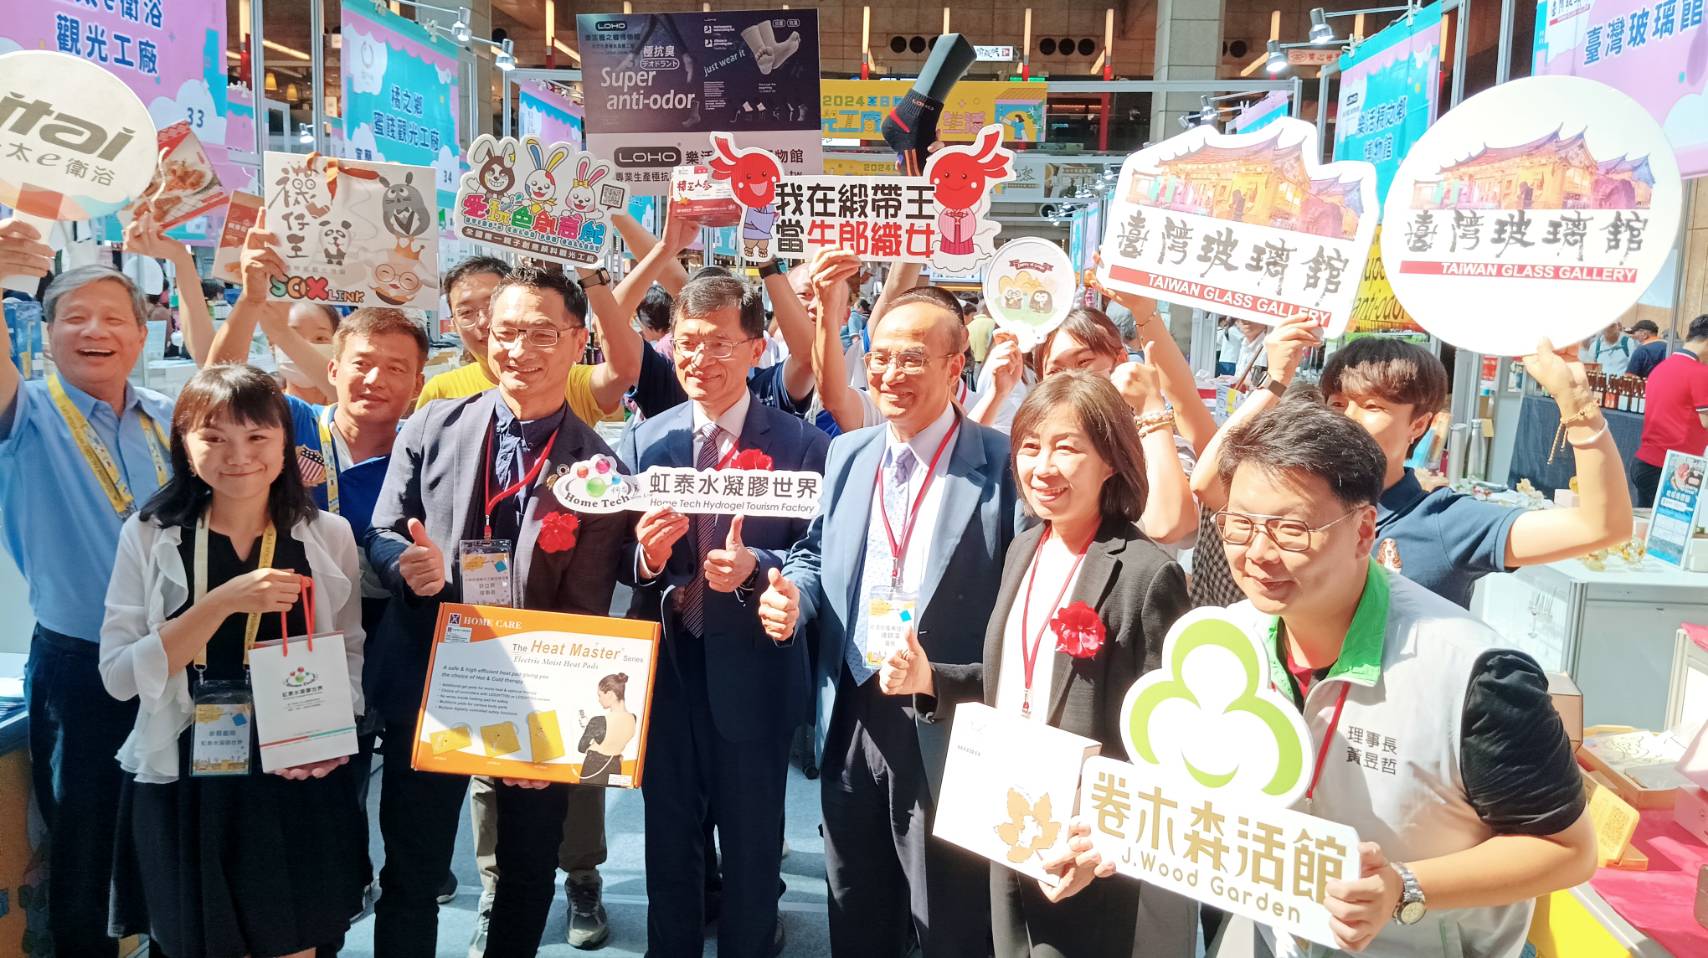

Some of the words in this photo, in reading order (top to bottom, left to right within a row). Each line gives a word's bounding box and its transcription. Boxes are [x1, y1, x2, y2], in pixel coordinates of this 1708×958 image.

[597, 22, 626, 30] LOHO
[1584, 0, 1703, 65] 臺灣玻璃館
[56, 14, 157, 73] 觀光工廠
[644, 46, 675, 57] 極抗臭
[704, 64, 719, 77] just
[720, 54, 738, 67] wear
[740, 49, 746, 58] it
[601, 67, 656, 92] Super
[607, 90, 695, 110] anti-odor
[187, 107, 204, 128] 33
[0, 143, 116, 187] 太e衛浴
[619, 152, 677, 163] LOHO
[616, 172, 672, 182] 專業生產極抗
[776, 183, 935, 219] 我在緞帶王
[776, 219, 935, 258] 當牛郎織女
[1405, 210, 1648, 265] 臺灣玻璃館
[1117, 210, 1349, 307] 臺灣玻璃館
[1441, 262, 1497, 276] TAIWAN
[1501, 264, 1554, 278] GLASS
[1559, 267, 1635, 281] GALLERY
[1149, 274, 1200, 297] TAIWAN
[1203, 287, 1252, 309] GLASS
[650, 473, 818, 499] 虹泰水凝膠世界
[564, 493, 598, 508] Home
[601, 495, 630, 508] Tech
[680, 500, 700, 508] Tech
[703, 501, 744, 511] Hydrogel
[747, 502, 779, 511] Tourism
[781, 503, 815, 513] Factory
[464, 617, 493, 627] HOME
[496, 620, 522, 629] CARE
[512, 643, 527, 653] The
[531, 640, 565, 655] Heat
[570, 643, 621, 660] Master
[1348, 726, 1397, 755] 理事長
[1346, 746, 1397, 775] 黃昱哲
[1091, 772, 1346, 904] 卷木森活館
[1122, 847, 1198, 887] J.Wood
[1210, 876, 1300, 923] Garden
